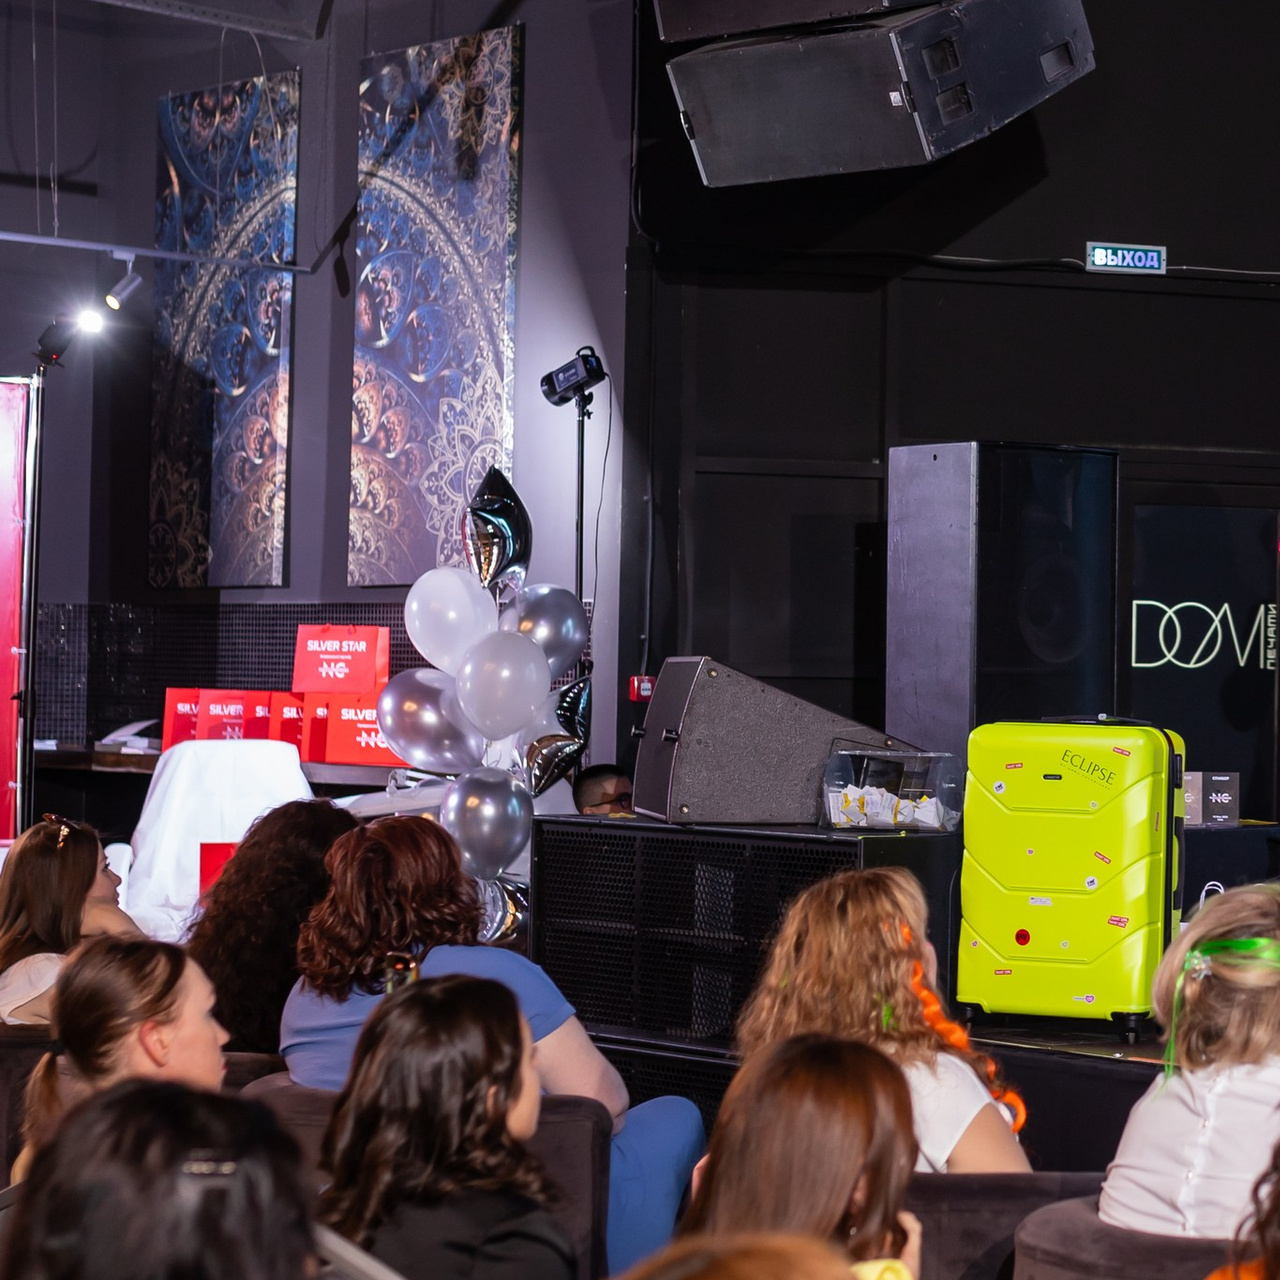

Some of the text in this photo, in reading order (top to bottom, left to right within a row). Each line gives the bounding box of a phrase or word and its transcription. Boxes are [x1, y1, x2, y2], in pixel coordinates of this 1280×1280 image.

[1094, 248, 1159, 268] ВЫХОД
[306, 639, 367, 653] SILVER STAR
[1266, 603, 1278, 670] ПЕЧАТИ
[1061, 749, 1117, 786] ECLIPSE
